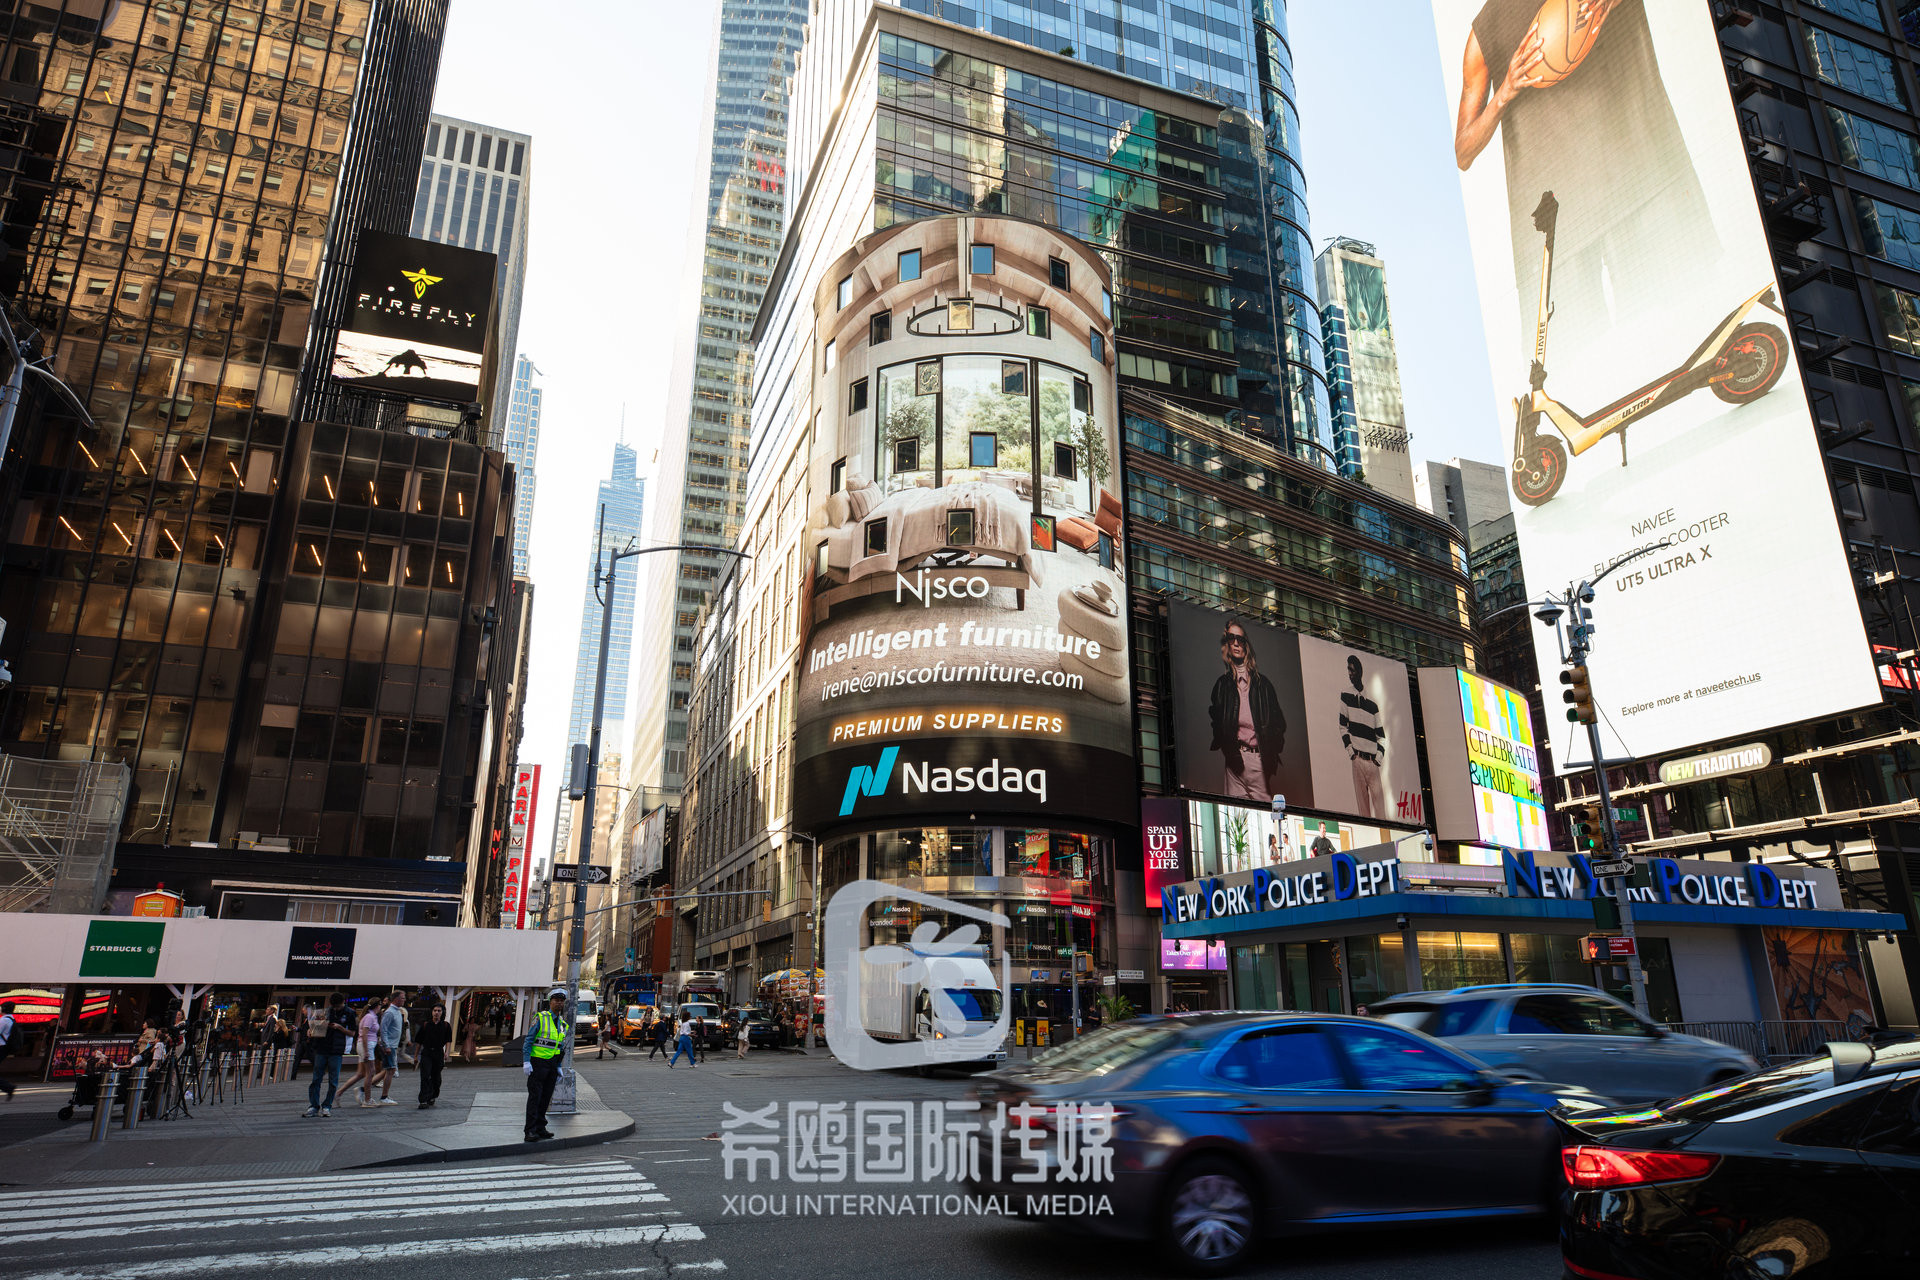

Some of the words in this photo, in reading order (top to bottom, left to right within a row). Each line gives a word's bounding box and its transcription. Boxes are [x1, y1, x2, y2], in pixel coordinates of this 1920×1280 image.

[357, 303, 472, 327] AEROSPACE
[358, 293, 475, 321] FIREFLY
[1631, 508, 1676, 537] NAVEE
[1658, 512, 1730, 551] SCOOTER
[1616, 571, 1645, 592] UT5
[1647, 552, 1696, 580] ULTRA
[1699, 544, 1713, 561] X
[809, 621, 949, 674] Intelligent
[959, 620, 1101, 660] furniture
[821, 660, 1084, 702] irene@niscofurniture.com
[1621, 699, 1655, 717] Explore
[1656, 693, 1681, 707] more
[1683, 689, 1693, 700] at
[1695, 671, 1762, 698] naveetech.us
[833, 714, 923, 743] PREMIUM
[932, 712, 1063, 734] SUPPLIERS
[902, 758, 1047, 804] Nasdaq
[1481, 763, 1518, 797] PRIDE
[513, 772, 531, 825] PARK
[1396, 790, 1422, 822] H&M
[1147, 826, 1177, 835] SPAIN
[1149, 834, 1178, 850] UP
[1148, 850, 1178, 859] YOUR
[1149, 858, 1179, 870] LIFE
[1595, 866, 1608, 874] ONE
[503, 858, 521, 912] PARK
[561, 869, 577, 877] ONE
[1253, 868, 1325, 912] POLICE
[1331, 853, 1399, 900] DEPT
[1653, 858, 1749, 906] POLICE
[1748, 864, 1817, 909] DEPT
[1026, 906, 1047, 914] Nasdaq
[89, 945, 142, 953] STARBUCKS
[1032, 944, 1052, 952] Nasdaq
